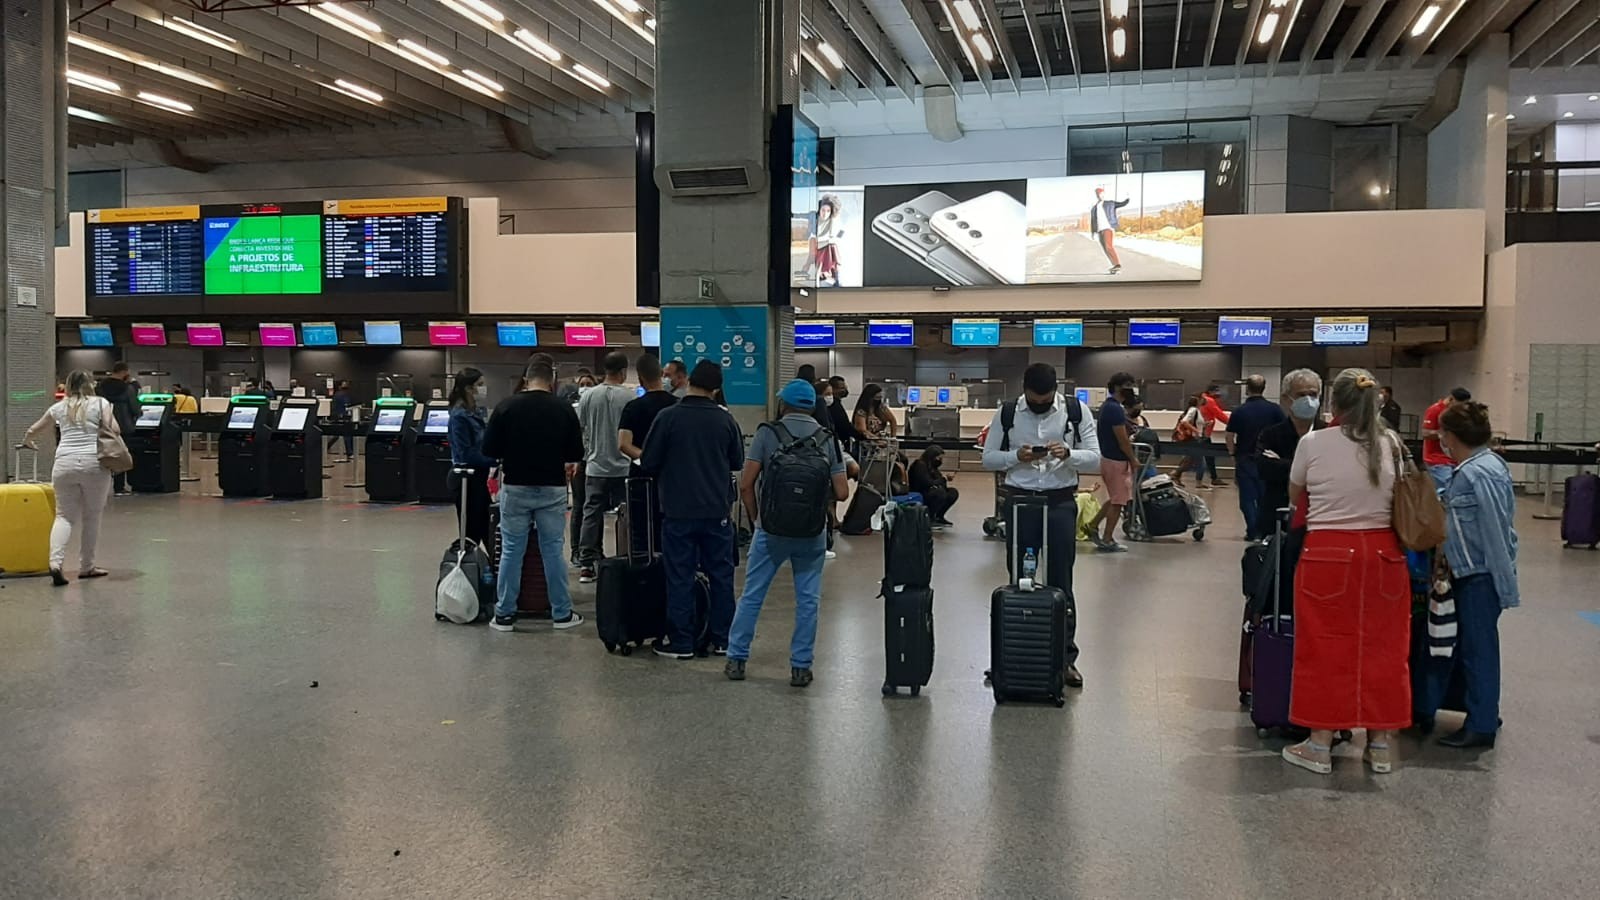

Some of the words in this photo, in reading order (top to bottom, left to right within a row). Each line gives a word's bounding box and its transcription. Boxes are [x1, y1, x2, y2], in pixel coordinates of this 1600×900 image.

[238, 254, 280, 262] PROJETOS
[282, 253, 295, 261] DE
[229, 263, 304, 273] INFRAESTRUTURA
[1239, 329, 1268, 337] LATAM
